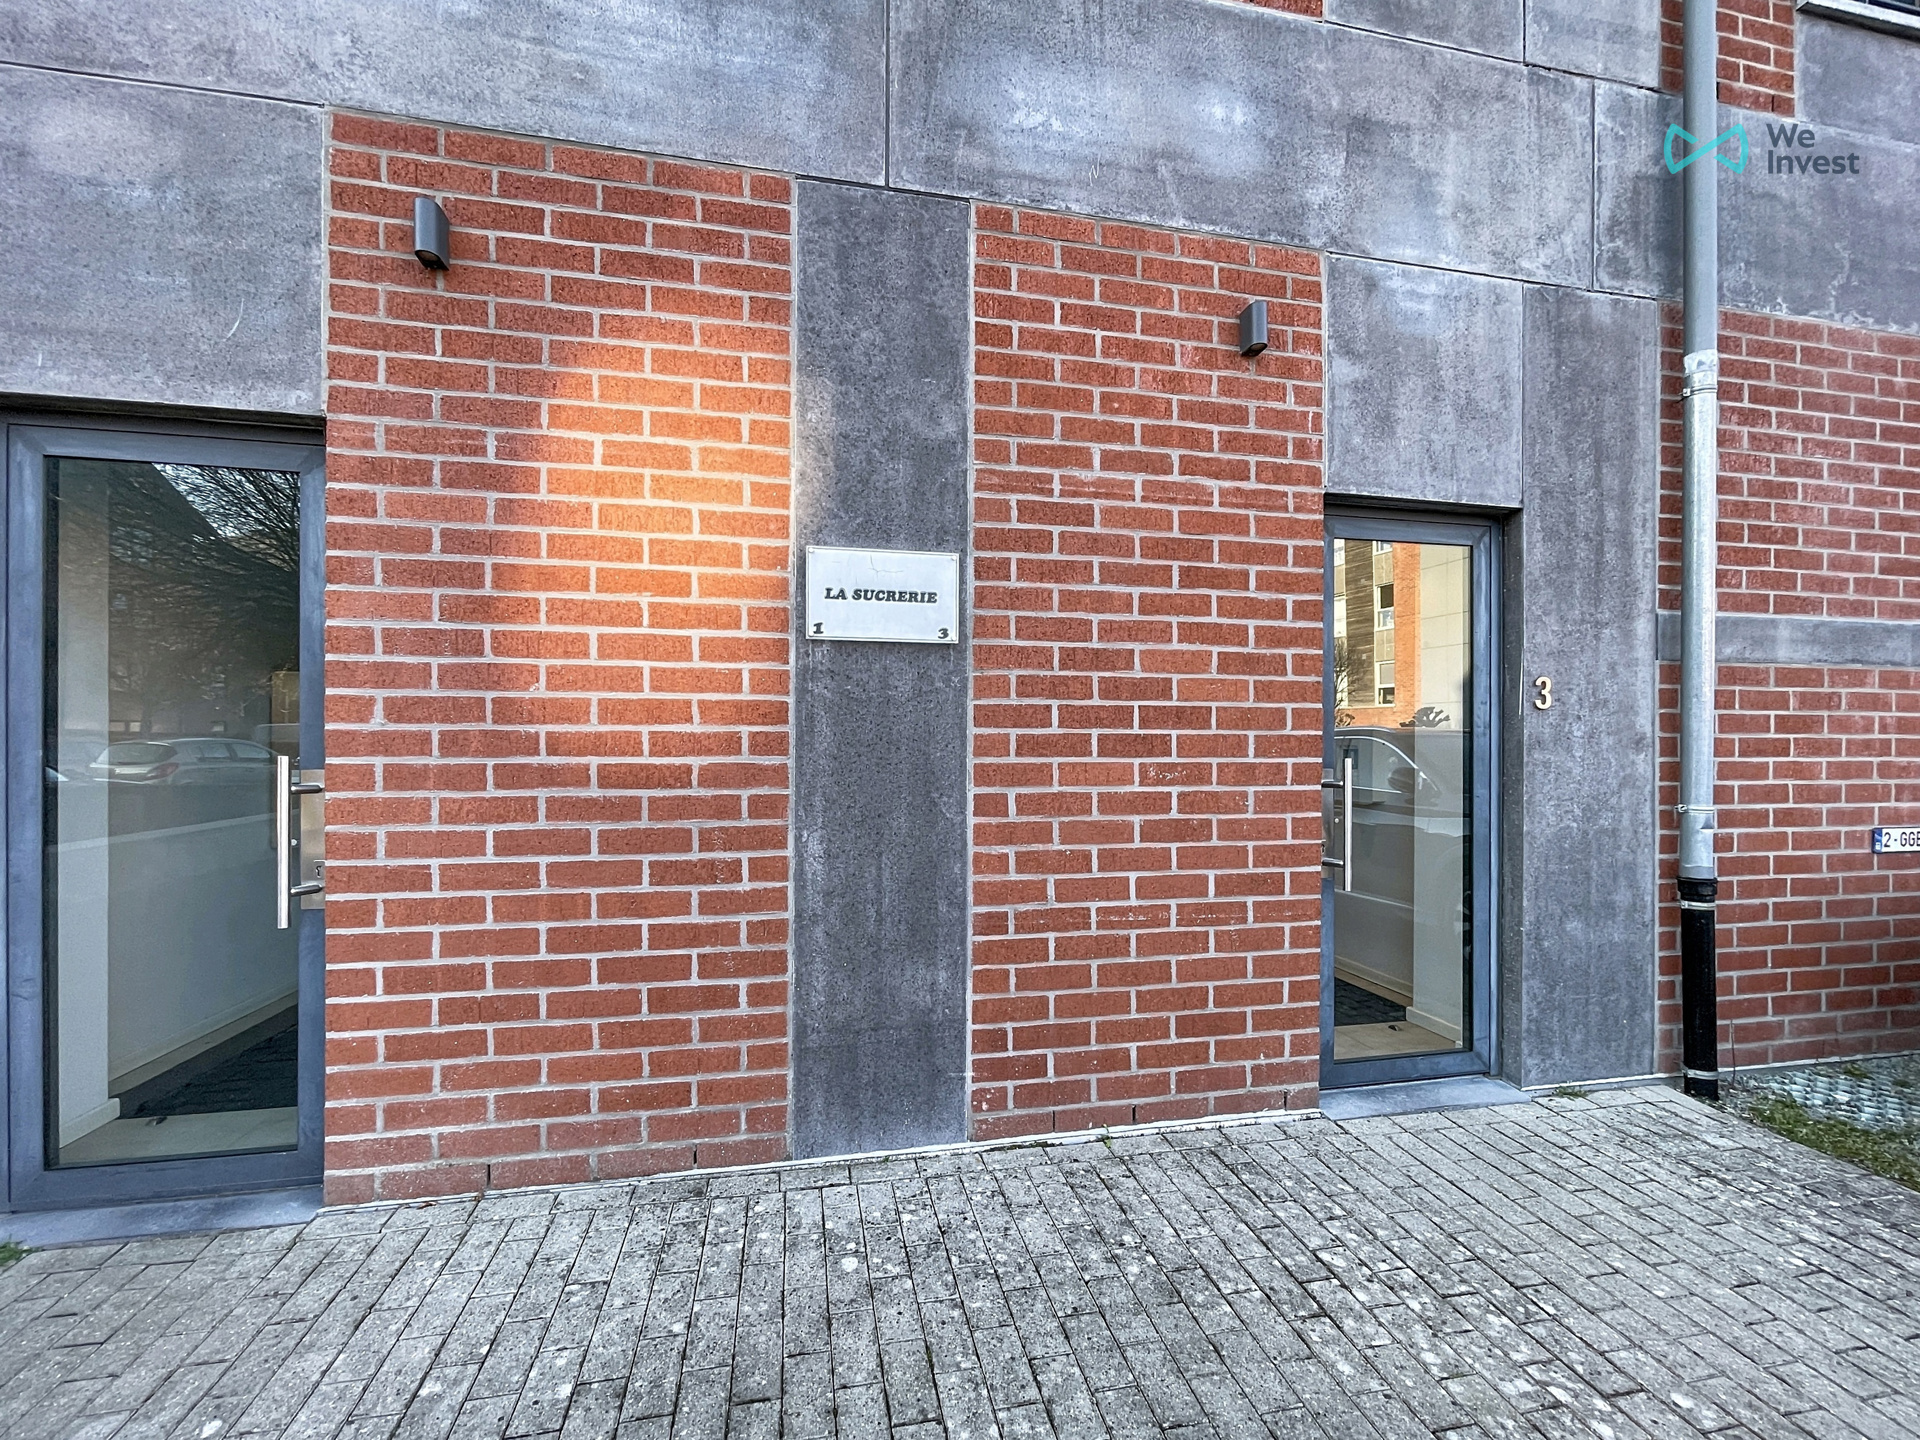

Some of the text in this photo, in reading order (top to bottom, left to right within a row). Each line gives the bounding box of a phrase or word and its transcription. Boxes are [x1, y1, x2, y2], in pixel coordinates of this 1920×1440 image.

[824, 587, 938, 603] LA SUCRERIE
[813, 622, 824, 634] 1
[937, 628, 949, 639] 3
[1534, 676, 1552, 710] 3
